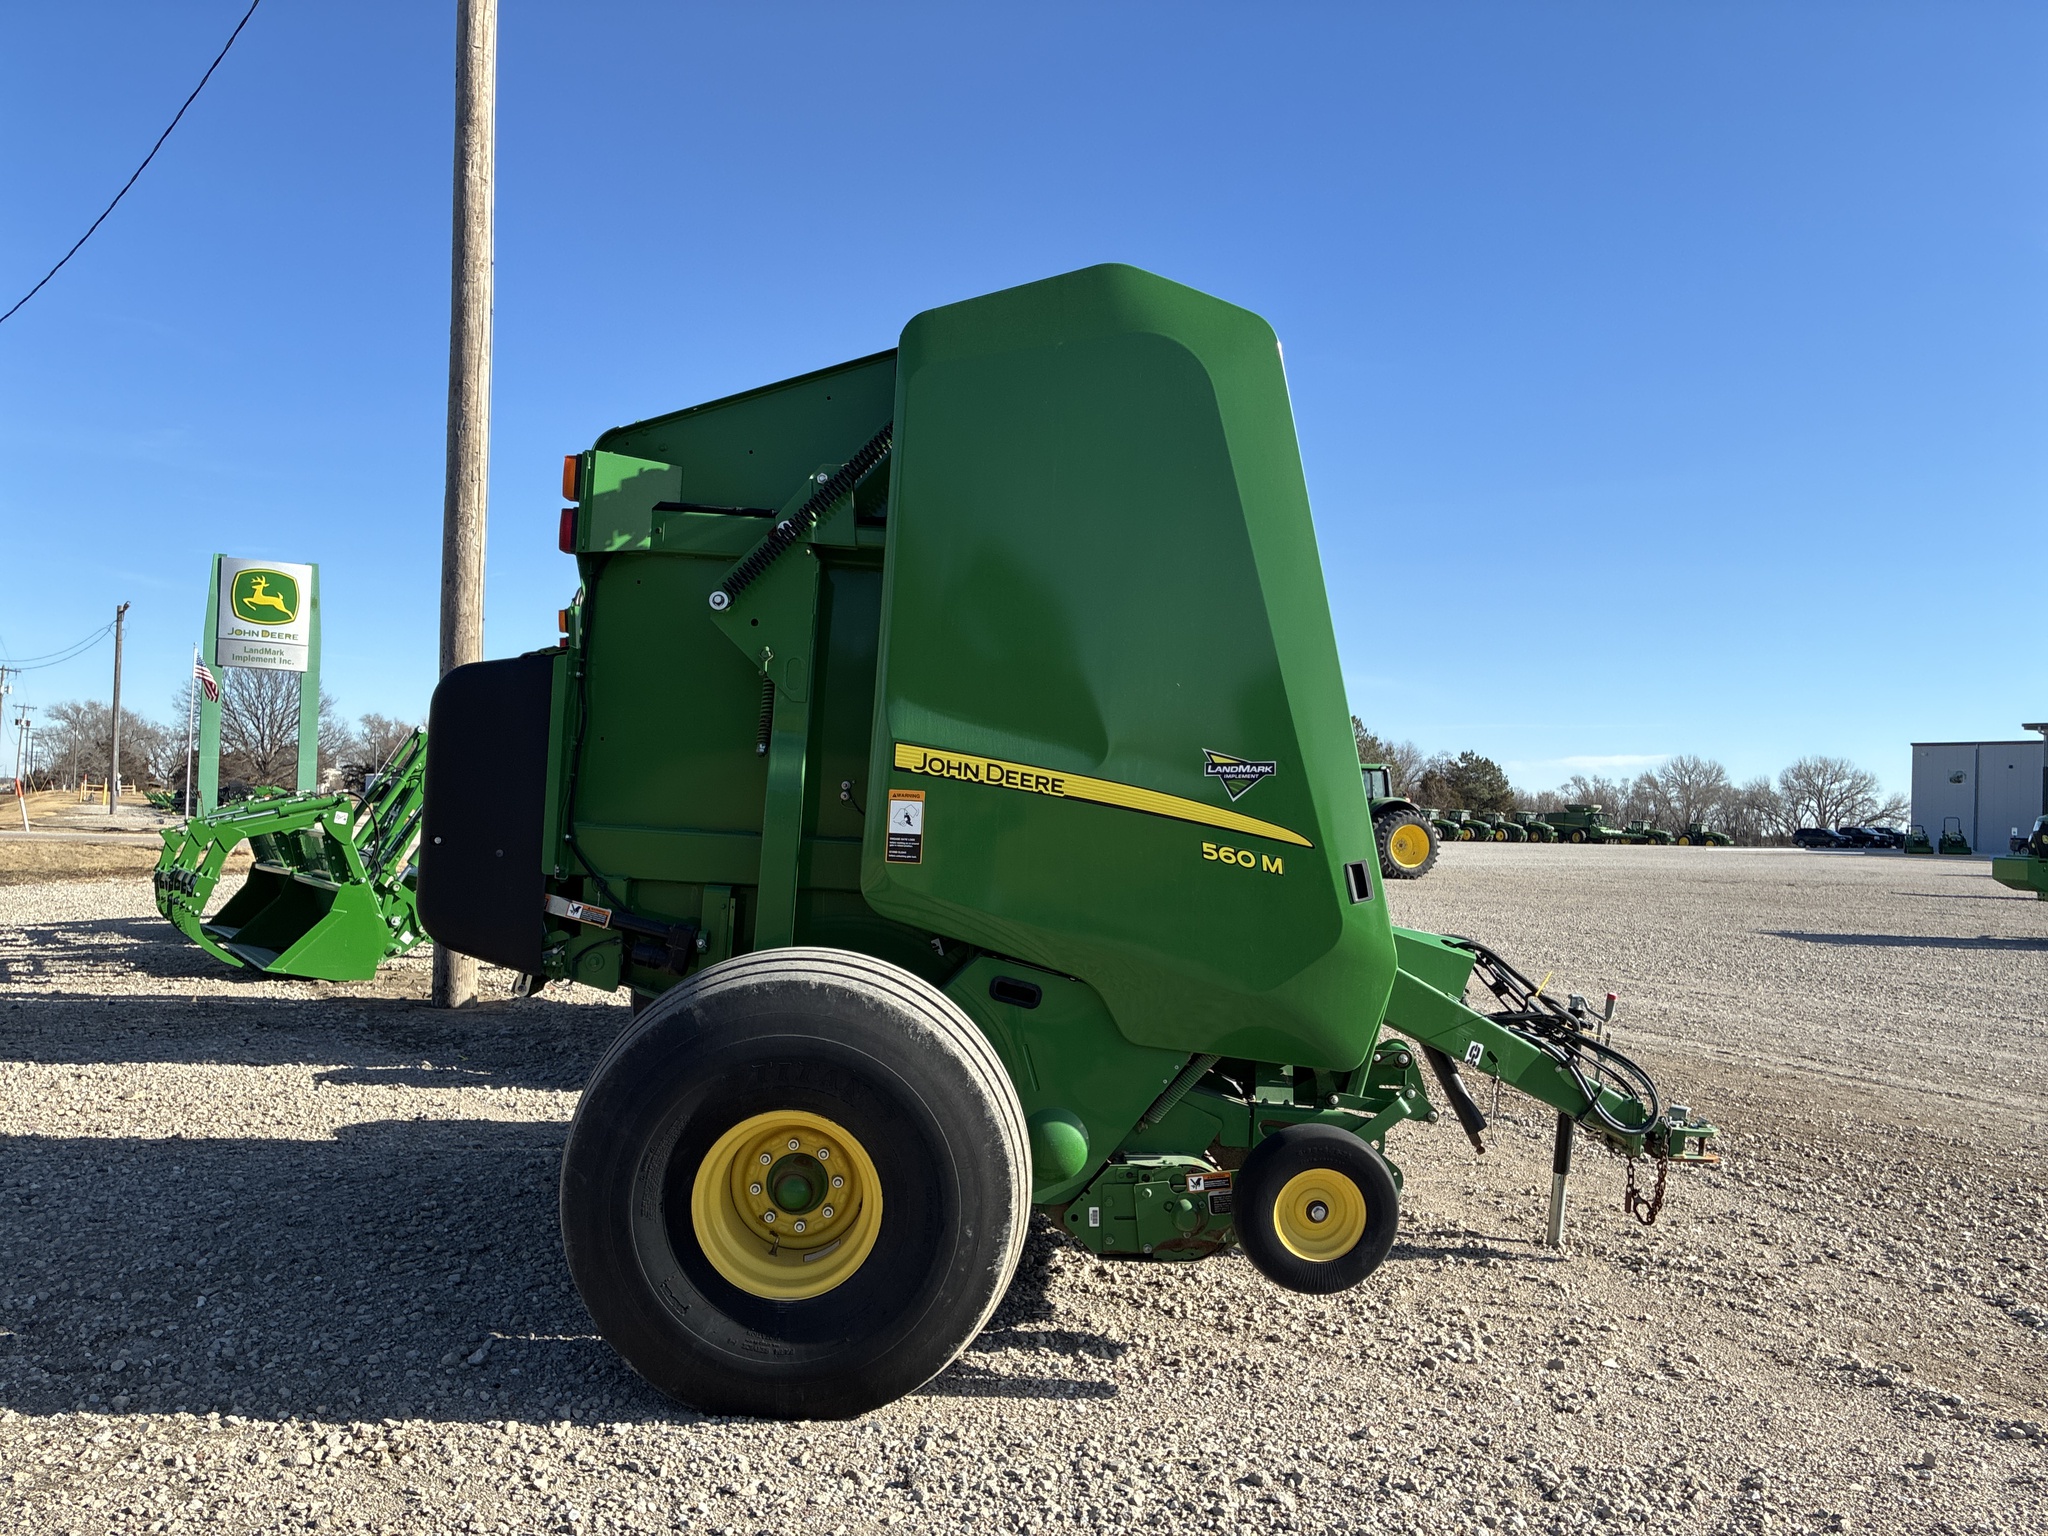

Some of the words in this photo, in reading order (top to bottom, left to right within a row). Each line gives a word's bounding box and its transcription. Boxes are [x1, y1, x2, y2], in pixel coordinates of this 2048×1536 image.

[227, 627, 260, 637] JOHN
[261, 630, 299, 640] DEERE
[243, 646, 285, 656] LandMark
[232, 653, 277, 663] Implement
[279, 657, 295, 666] Inc.
[914, 752, 980, 780] JOHN
[986, 762, 1065, 795] DEERE
[1202, 841, 1257, 869] 560
[1261, 853, 1284, 875] M
